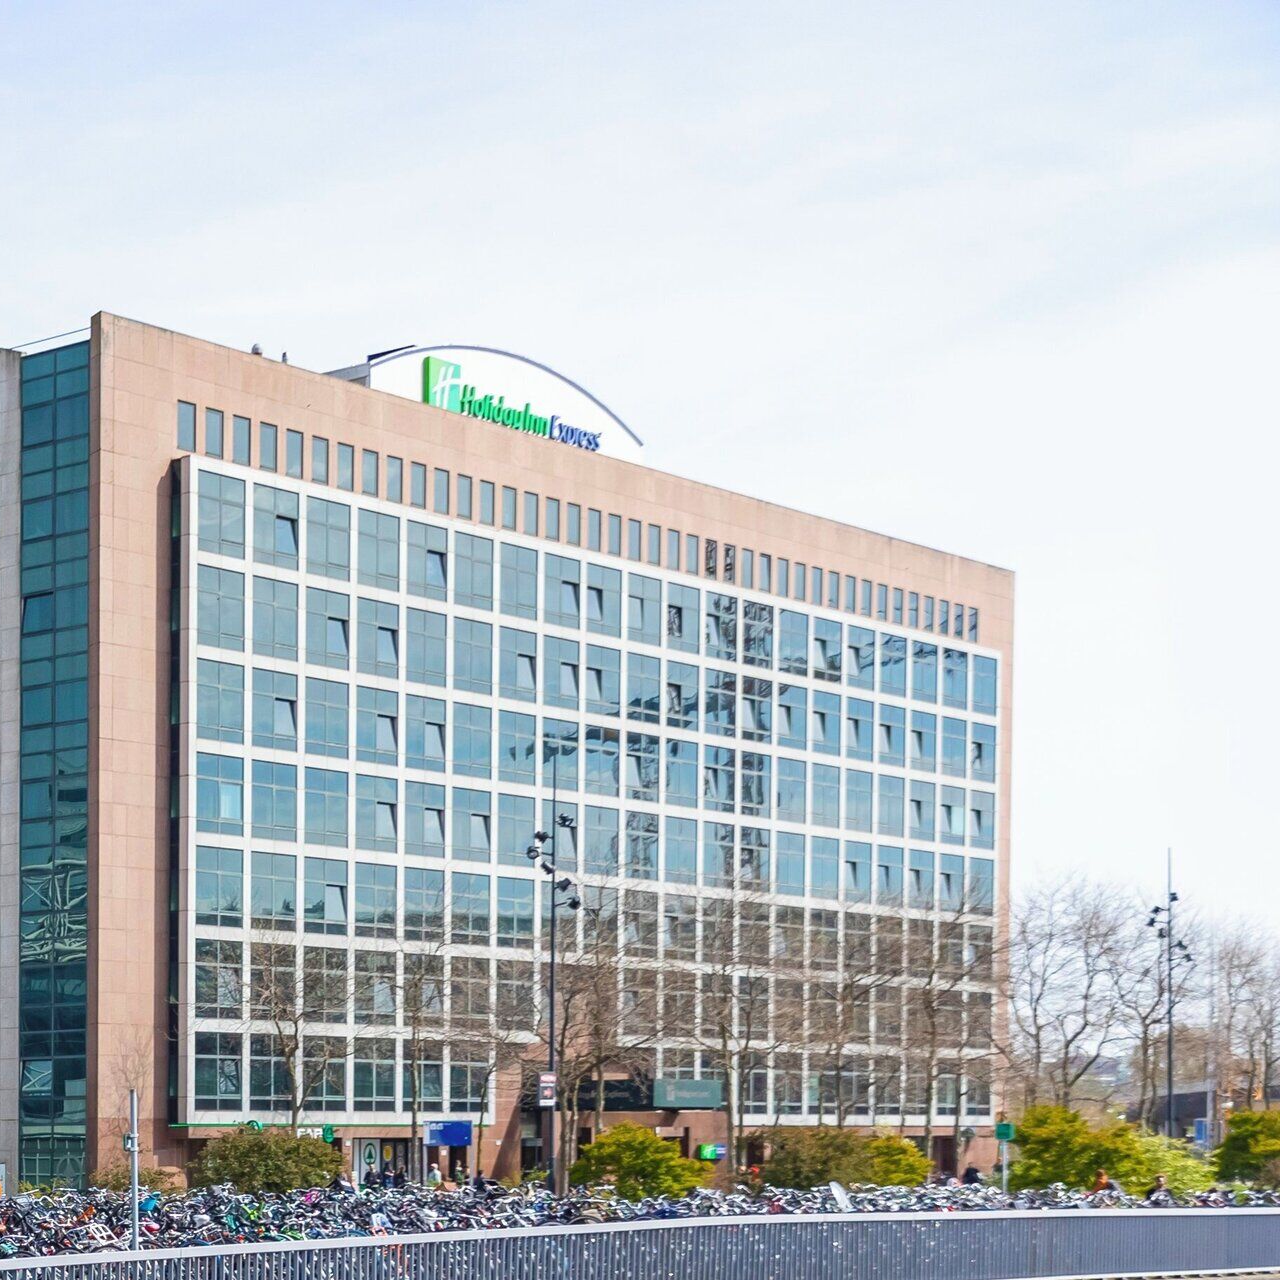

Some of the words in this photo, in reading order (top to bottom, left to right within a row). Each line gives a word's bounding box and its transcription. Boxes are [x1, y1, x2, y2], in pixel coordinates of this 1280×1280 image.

[460, 384, 524, 431] Holiday
[521, 402, 550, 438] Inn
[549, 414, 602, 452] Express
